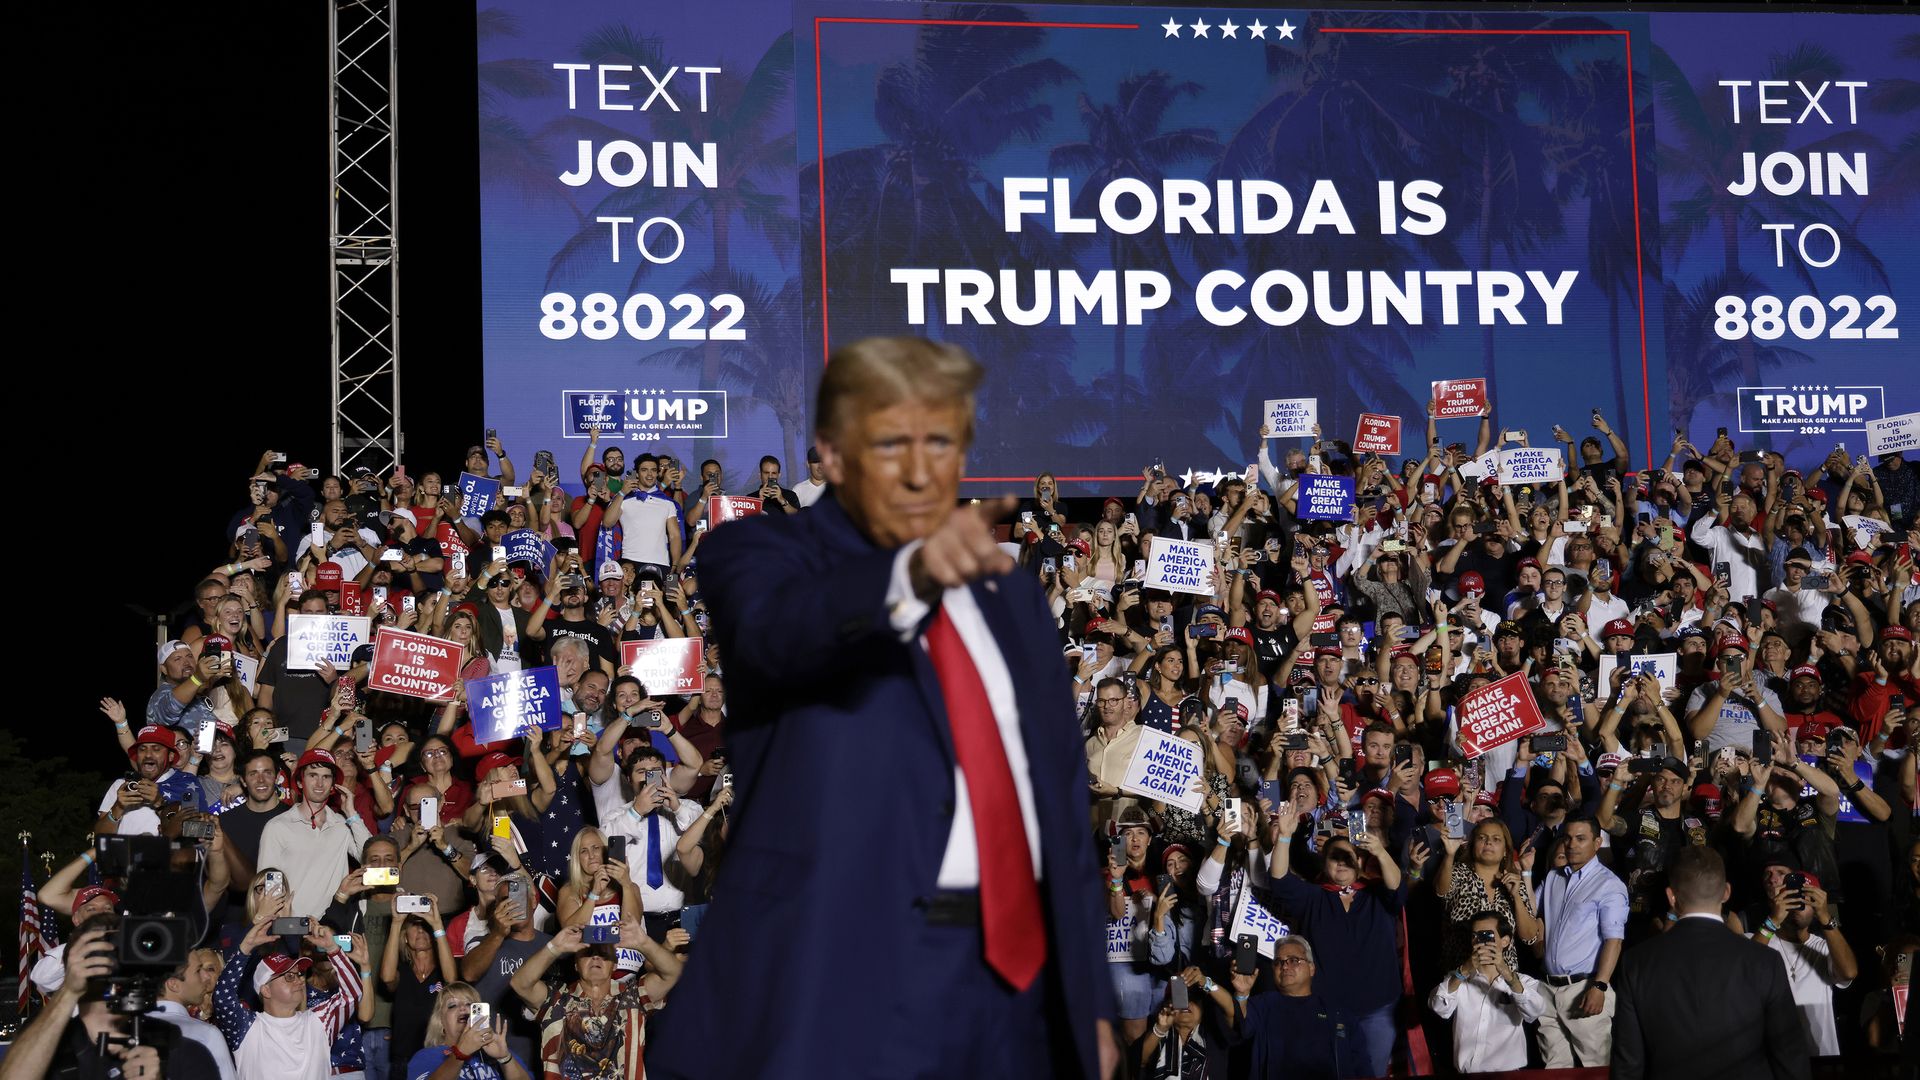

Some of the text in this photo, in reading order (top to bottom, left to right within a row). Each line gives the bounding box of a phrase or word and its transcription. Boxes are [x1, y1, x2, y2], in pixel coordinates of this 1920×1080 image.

[553, 63, 722, 113] TEXT
[1718, 80, 1868, 125] TEXT
[558, 139, 718, 189] JOIN
[1726, 151, 1869, 196] JOIN
[1003, 177, 1447, 235] FLORIDA IS
[596, 216, 685, 265] TO
[1761, 222, 1841, 268] TO
[890, 268, 1579, 326] TRUMP COUNTRY
[539, 292, 747, 341] 88022
[1714, 294, 1899, 340] 88022
[1443, 384, 1477, 392] FLORIDA
[1446, 398, 1474, 406] TRUMP
[1754, 394, 1868, 416] TRUMP
[624, 398, 709, 421] UMP
[1441, 405, 1480, 414] COUNTRY
[1275, 424, 1306, 432] AGAIN!
[1364, 418, 1390, 428] FLORIDA
[1876, 418, 1913, 430] FLORIDA
[632, 432, 660, 440] 2024
[1364, 434, 1387, 442] TRUMP
[1882, 434, 1912, 443] TRUMP
[1358, 442, 1392, 450] COUNTRY
[1877, 438, 1918, 450] COUNTRY
[1484, 458, 1497, 476] 022
[1506, 458, 1552, 466] AMERICA
[1512, 464, 1546, 472] GREAT
[1512, 470, 1548, 478] AGAIN!
[1314, 479, 1340, 488] MAKE
[460, 480, 476, 516] TO 8802
[1305, 488, 1348, 498] AMERICA
[470, 492, 480, 514] TRUMP
[476, 494, 490, 516] TEXT
[1310, 496, 1342, 506] GREAT
[1310, 505, 1342, 514] AGAIN!
[1169, 544, 1198, 556] MAKE
[1158, 554, 1207, 568] AMERICA
[1164, 564, 1201, 576] GREAT
[1160, 574, 1200, 586] AGAIN!
[311, 622, 348, 631] MAKE
[1312, 621, 1334, 630] ORIDA
[299, 632, 358, 642] AMERICA
[552, 628, 599, 645] Los Angeles
[307, 643, 350, 652] GREAT
[392, 639, 448, 659] FLORIDA
[636, 646, 688, 656] FLORIDA
[306, 654, 350, 663] AGAIN!
[412, 655, 424, 666] IS
[658, 658, 668, 666] IS
[394, 664, 440, 680] TRUMP
[644, 667, 684, 678] TRUMP
[382, 674, 446, 693] COUNTRY
[643, 678, 694, 688] OUNTRY
[482, 686, 550, 708] AMRICA
[1466, 688, 1504, 712] MAKE
[1461, 694, 1520, 727] AMERICA
[1720, 709, 1752, 720] TRUM
[494, 712, 546, 732] AAIN!
[1471, 708, 1516, 734] GREAT
[1476, 718, 1524, 746] AGAIN!
[1159, 740, 1192, 760] MAKE
[1144, 749, 1199, 776] AMERICA
[1147, 764, 1190, 786] GREAT
[1140, 776, 1186, 798] AGAIN!
[1244, 894, 1258, 927] AIN!
[593, 912, 620, 924] MA
[1107, 929, 1130, 940] EAT
[1107, 942, 1130, 952] AIN!
[616, 949, 643, 962] AIN!
